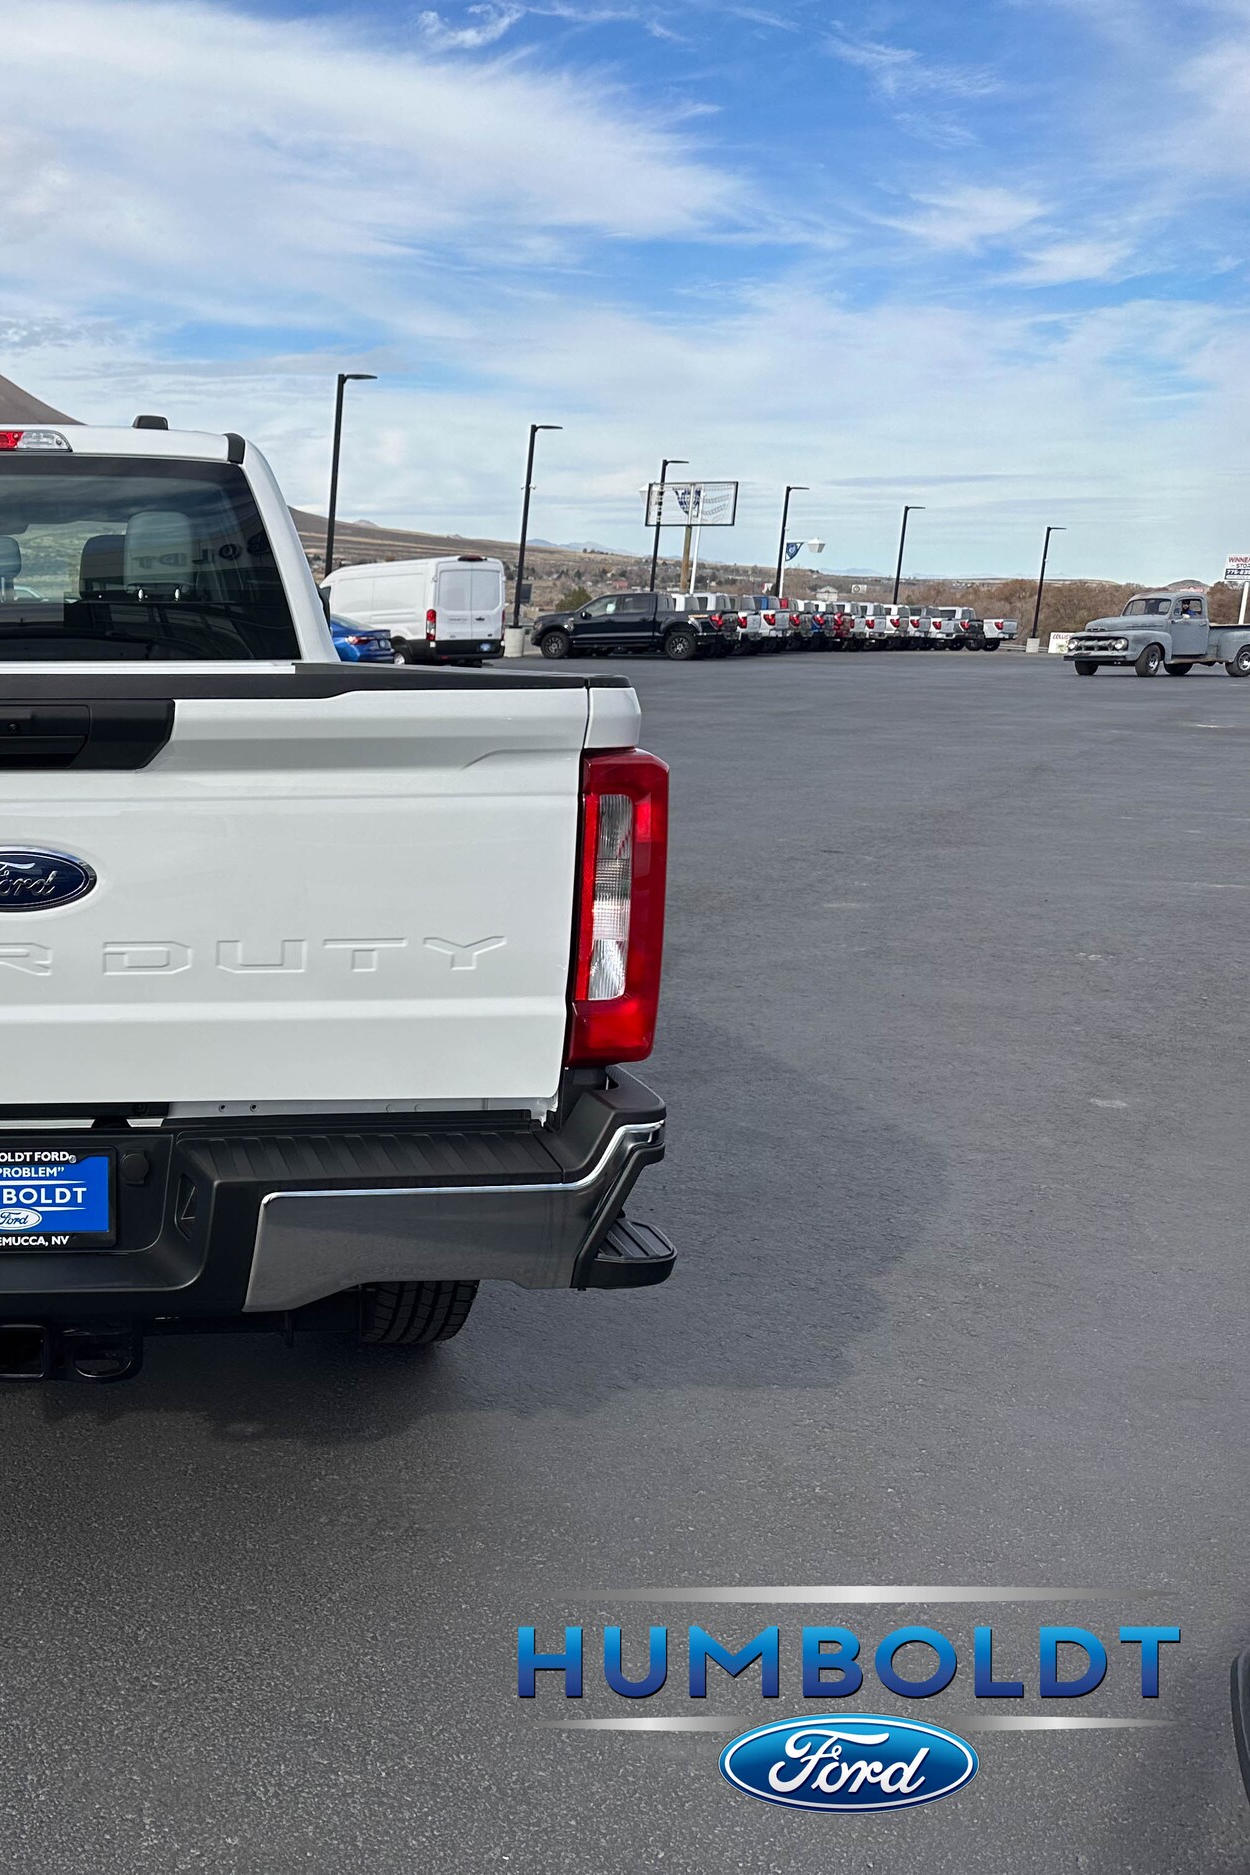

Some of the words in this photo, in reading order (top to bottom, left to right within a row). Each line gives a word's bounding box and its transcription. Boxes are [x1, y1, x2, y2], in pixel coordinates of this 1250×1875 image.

[102, 935, 507, 976] DUTY
[34, 1151, 70, 1162] FORD
[51, 1235, 70, 1246] NV
